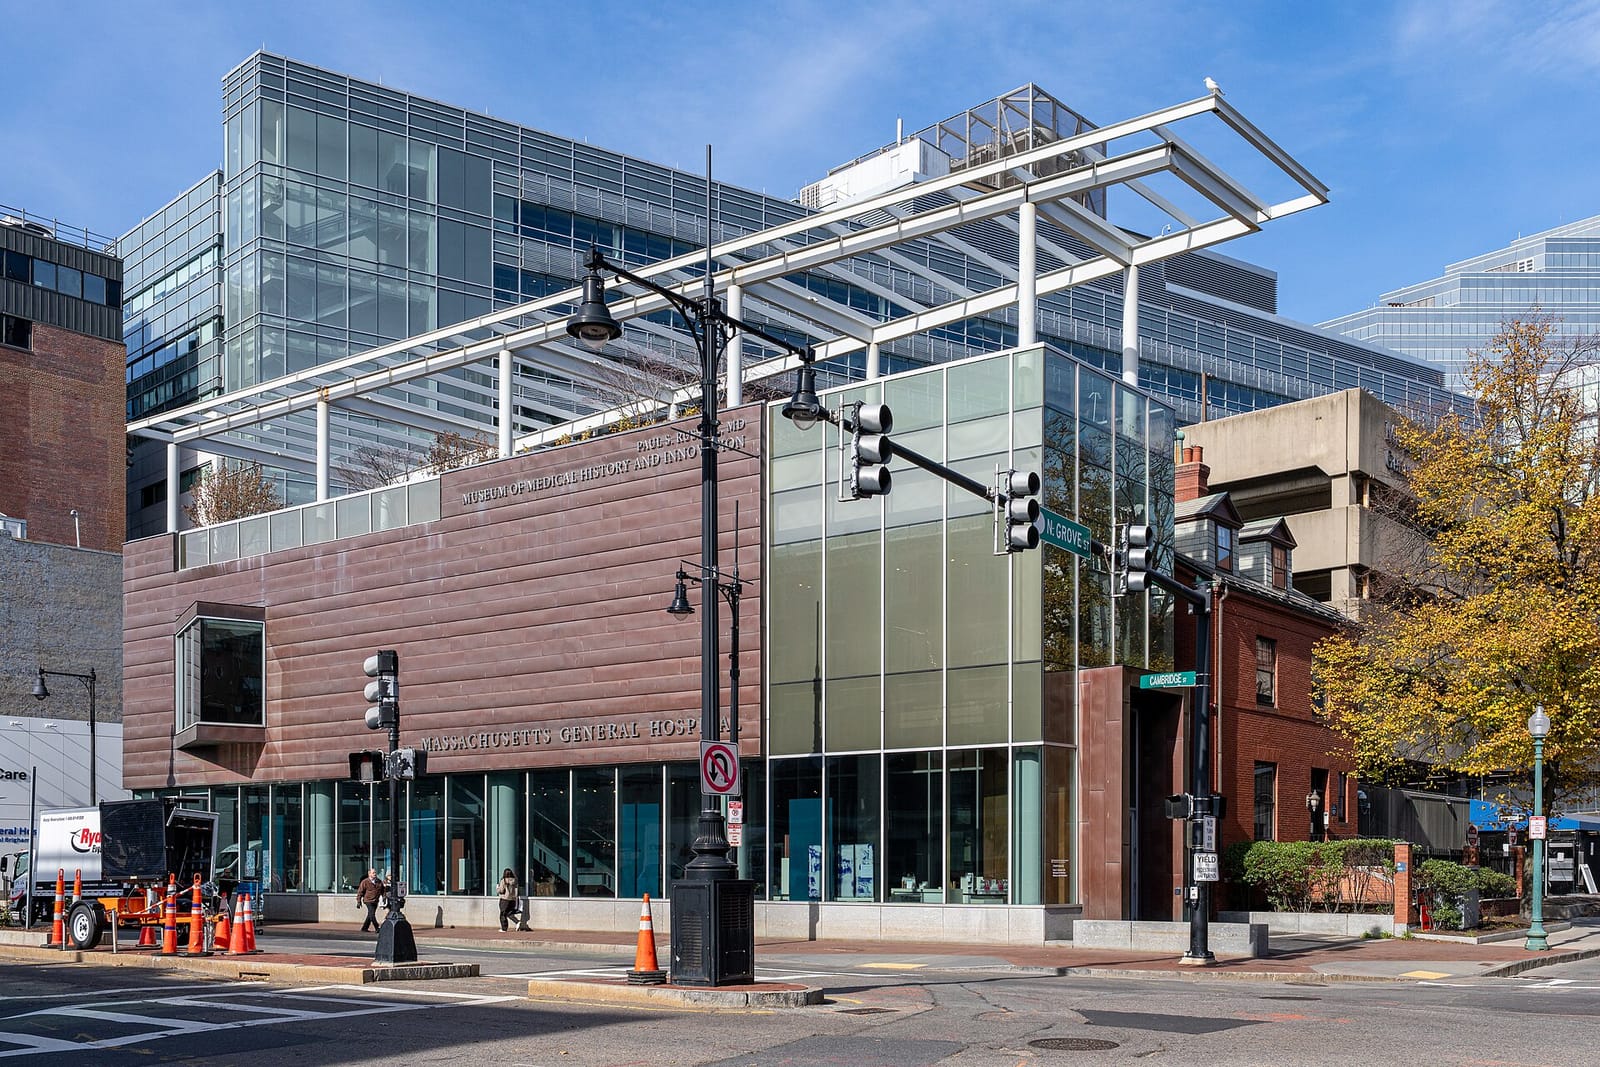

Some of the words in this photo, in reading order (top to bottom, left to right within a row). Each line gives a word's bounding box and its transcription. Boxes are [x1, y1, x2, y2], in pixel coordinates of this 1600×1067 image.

[637, 435, 664, 453] PAUL
[665, 434, 675, 446] S.
[727, 418, 746, 434] MD
[462, 485, 509, 505] MUSEUM
[510, 481, 525, 495] OF
[527, 471, 578, 493] MEDICAL
[580, 459, 631, 483] HISTORY
[634, 454, 661, 471] AND
[1056, 523, 1082, 548] GROVE
[1149, 673, 1182, 686] CAMBRIDGE
[421, 728, 552, 752] MASSACHUSETTS
[560, 721, 641, 743] GENERAL
[1196, 855, 1217, 863] YIELD
